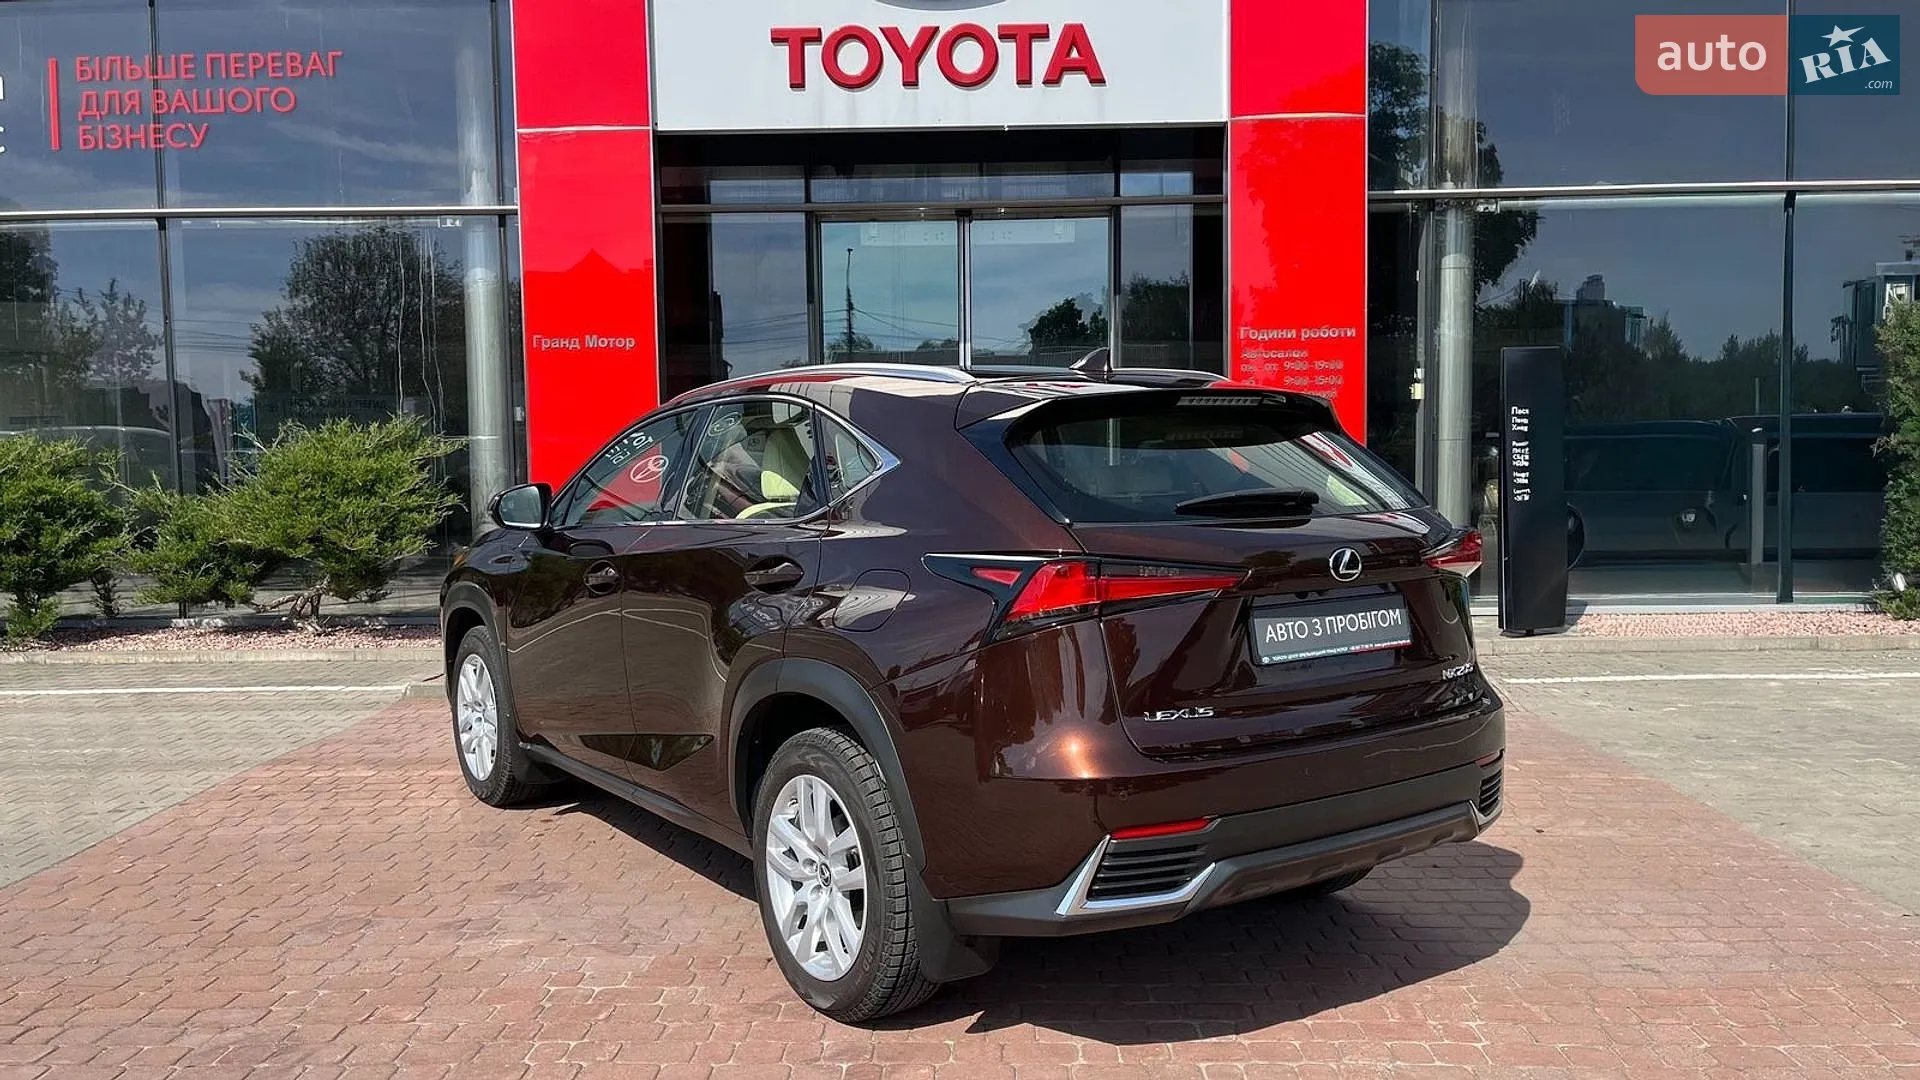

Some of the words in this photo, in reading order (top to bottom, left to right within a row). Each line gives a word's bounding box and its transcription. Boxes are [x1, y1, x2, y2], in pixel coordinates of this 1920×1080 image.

[75, 53, 196, 82] БІЛЬШЕ
[204, 50, 344, 79] ПЕРЕВАГ
[770, 22, 1106, 88] TOYOTA
[77, 89, 142, 121] ДЛЯ
[151, 86, 296, 115] ВАШОГО
[78, 122, 209, 150] БІЗНЕСУ
[532, 334, 580, 351] Гранд
[585, 334, 636, 350] Мотор
[1240, 326, 1297, 341] Години
[1301, 325, 1357, 341] роботи
[1265, 620, 1309, 643] АВТО
[1312, 618, 1323, 637] З
[1325, 608, 1402, 635] ПРОБІГОМ
